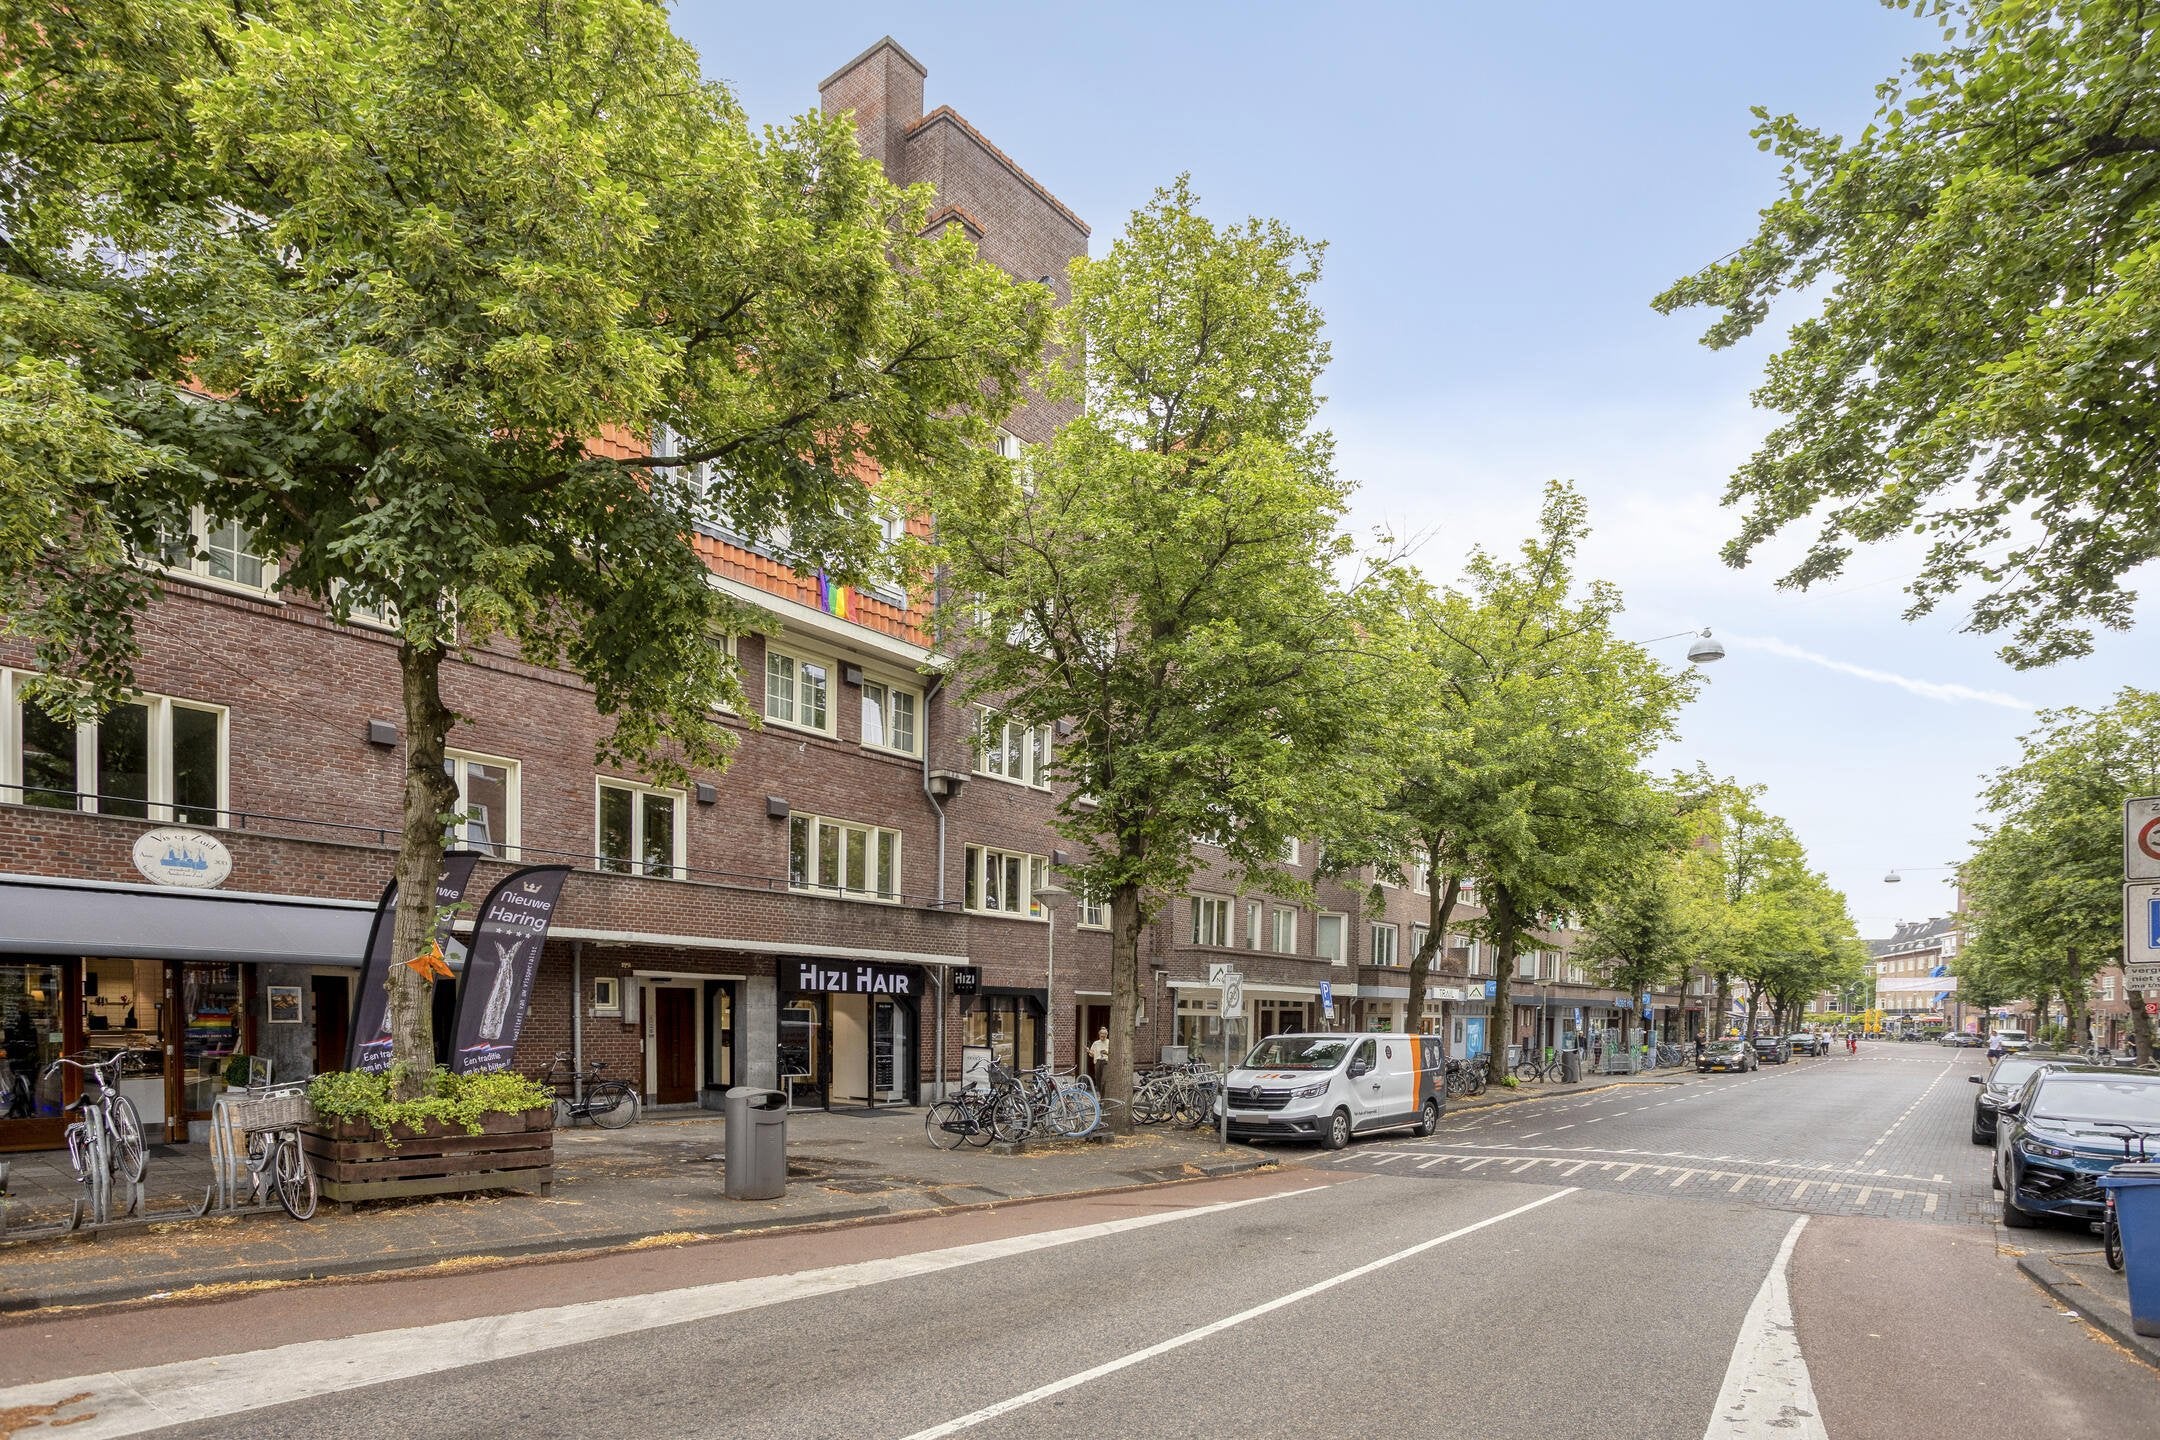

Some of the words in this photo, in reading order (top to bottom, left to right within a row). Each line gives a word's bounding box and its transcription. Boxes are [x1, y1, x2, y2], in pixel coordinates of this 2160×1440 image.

[150, 833, 170, 842] Vis
[488, 905, 547, 932] Haring
[800, 963, 847, 991] HIZI
[856, 966, 909, 994] HAIR
[955, 972, 975, 984] HIZI
[363, 1052, 379, 1062] Een
[463, 1057, 478, 1067] Een
